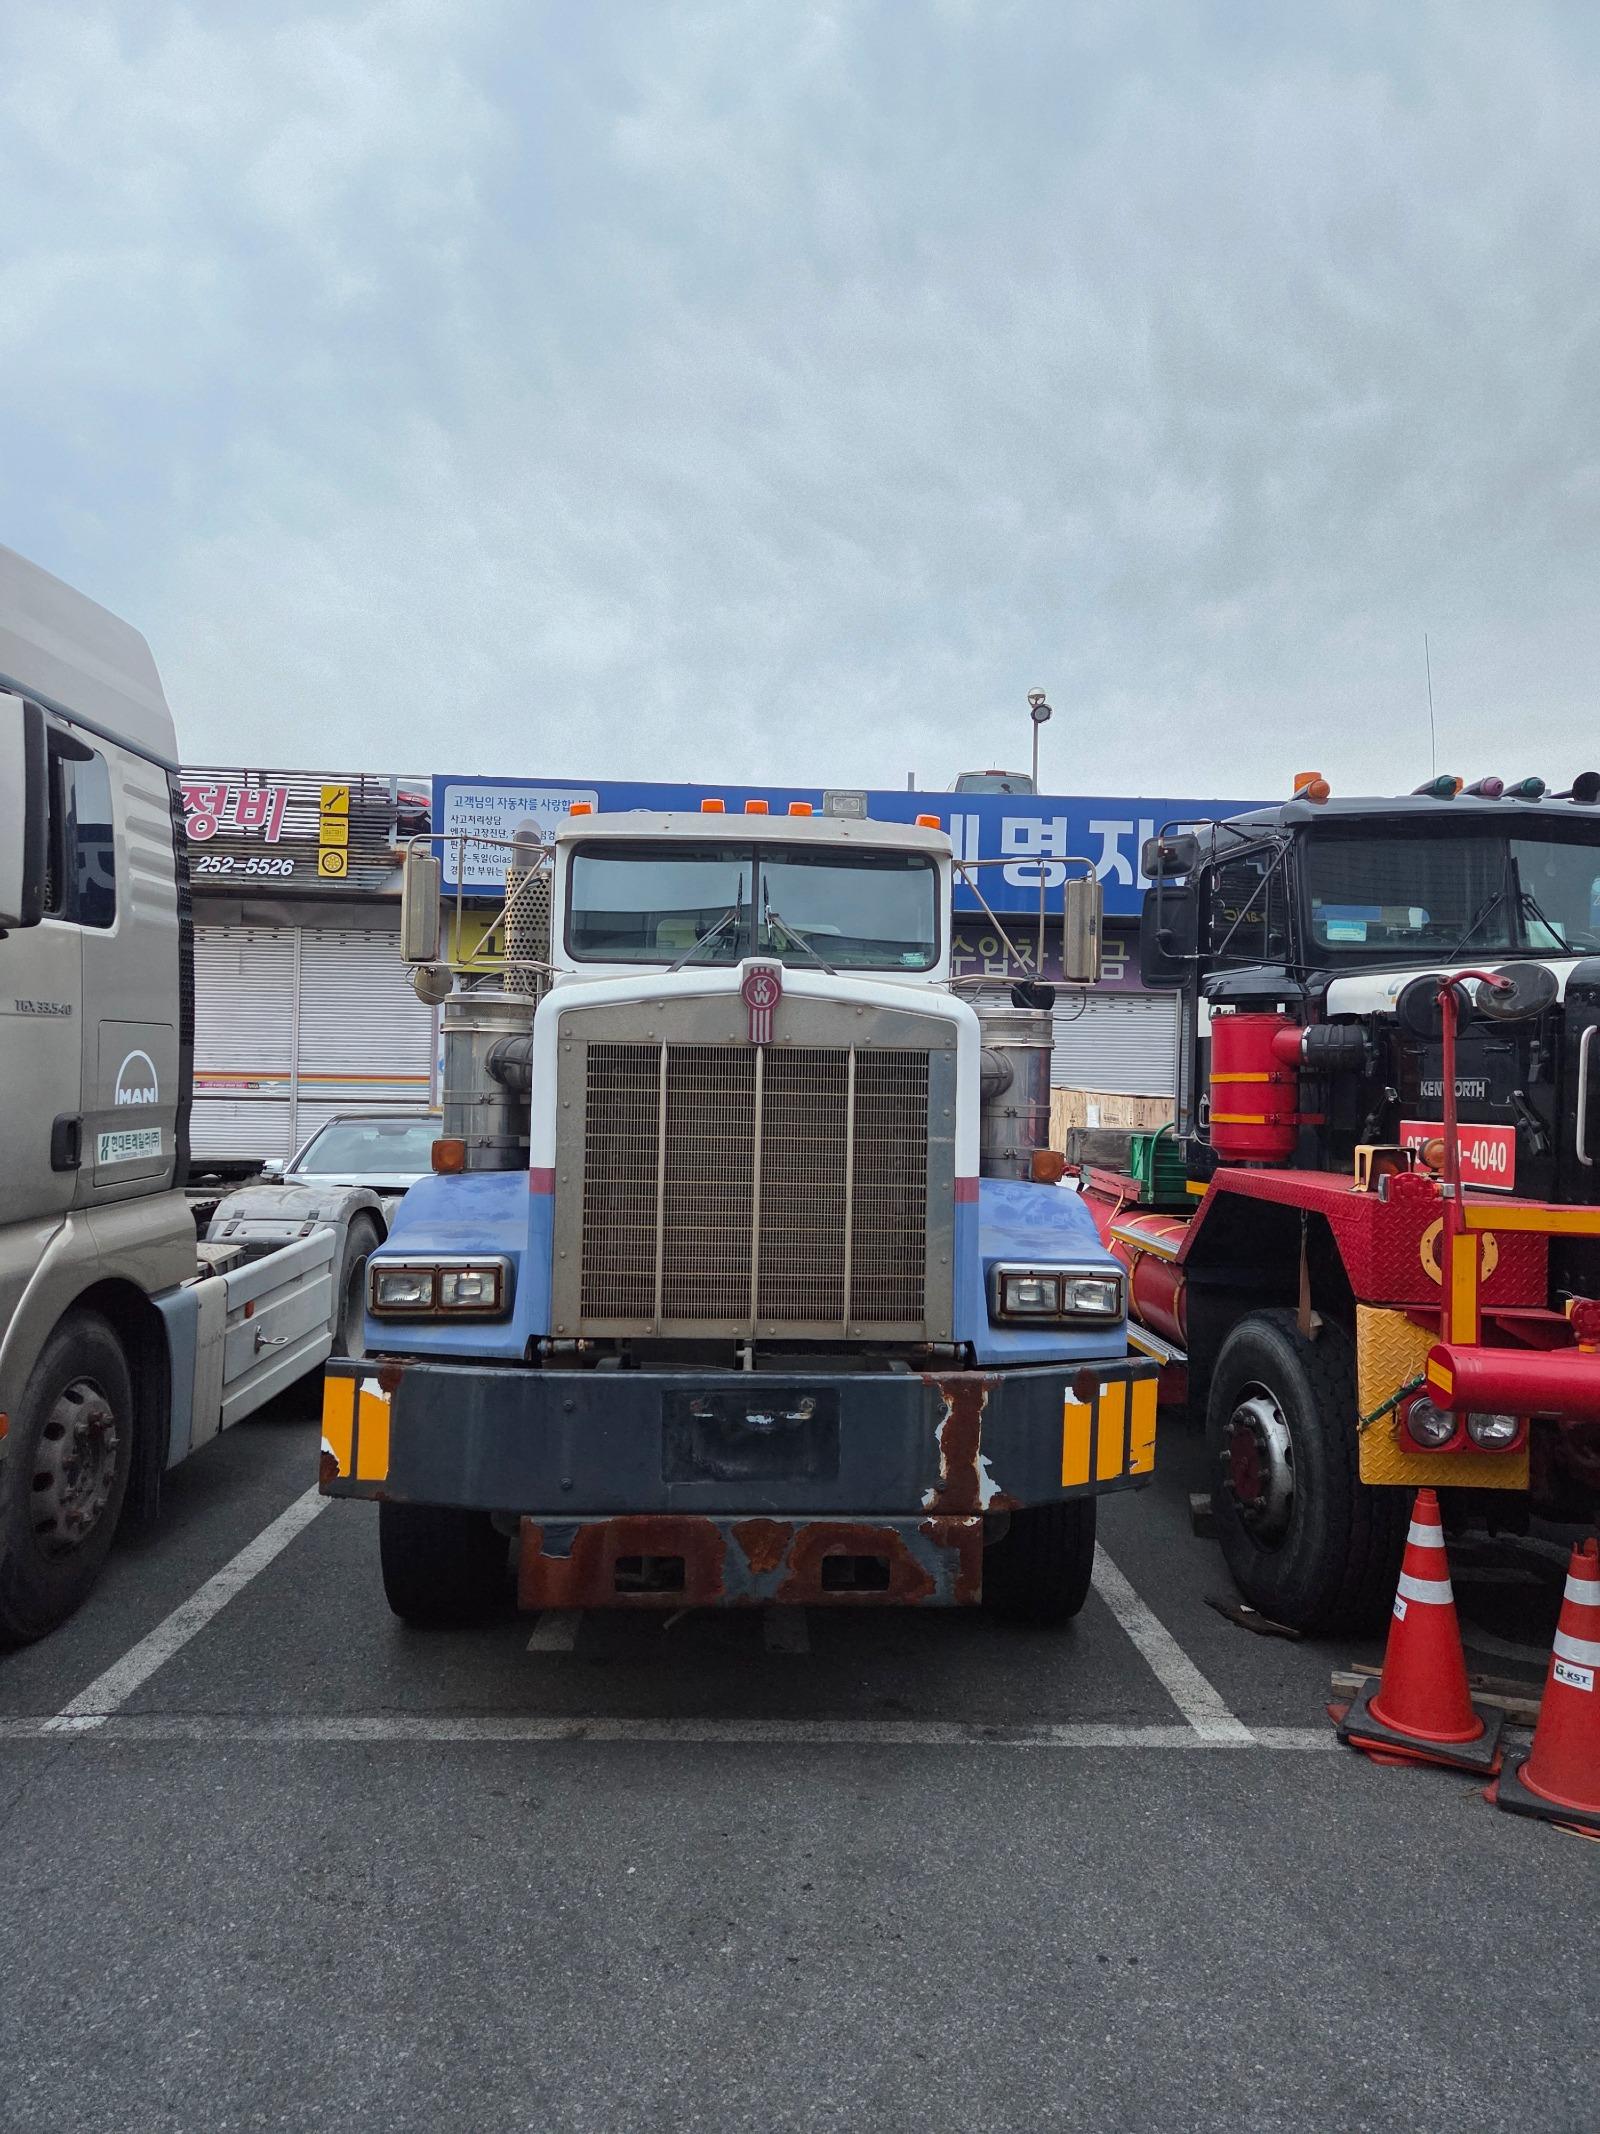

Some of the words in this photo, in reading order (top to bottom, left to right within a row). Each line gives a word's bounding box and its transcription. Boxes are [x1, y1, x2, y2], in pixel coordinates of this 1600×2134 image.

[453, 795, 494, 810] 고객님의
[497, 797, 539, 811] 자동차를
[541, 799, 592, 813] 사랑합
[180, 784, 290, 843] 정비
[450, 815, 502, 826] 사고처리상담
[196, 856, 295, 876] 252-5526
[450, 865, 475, 876] 경한
[118, 1087, 156, 1105] MAN
[1420, 1081, 1485, 1098] KENORTH
